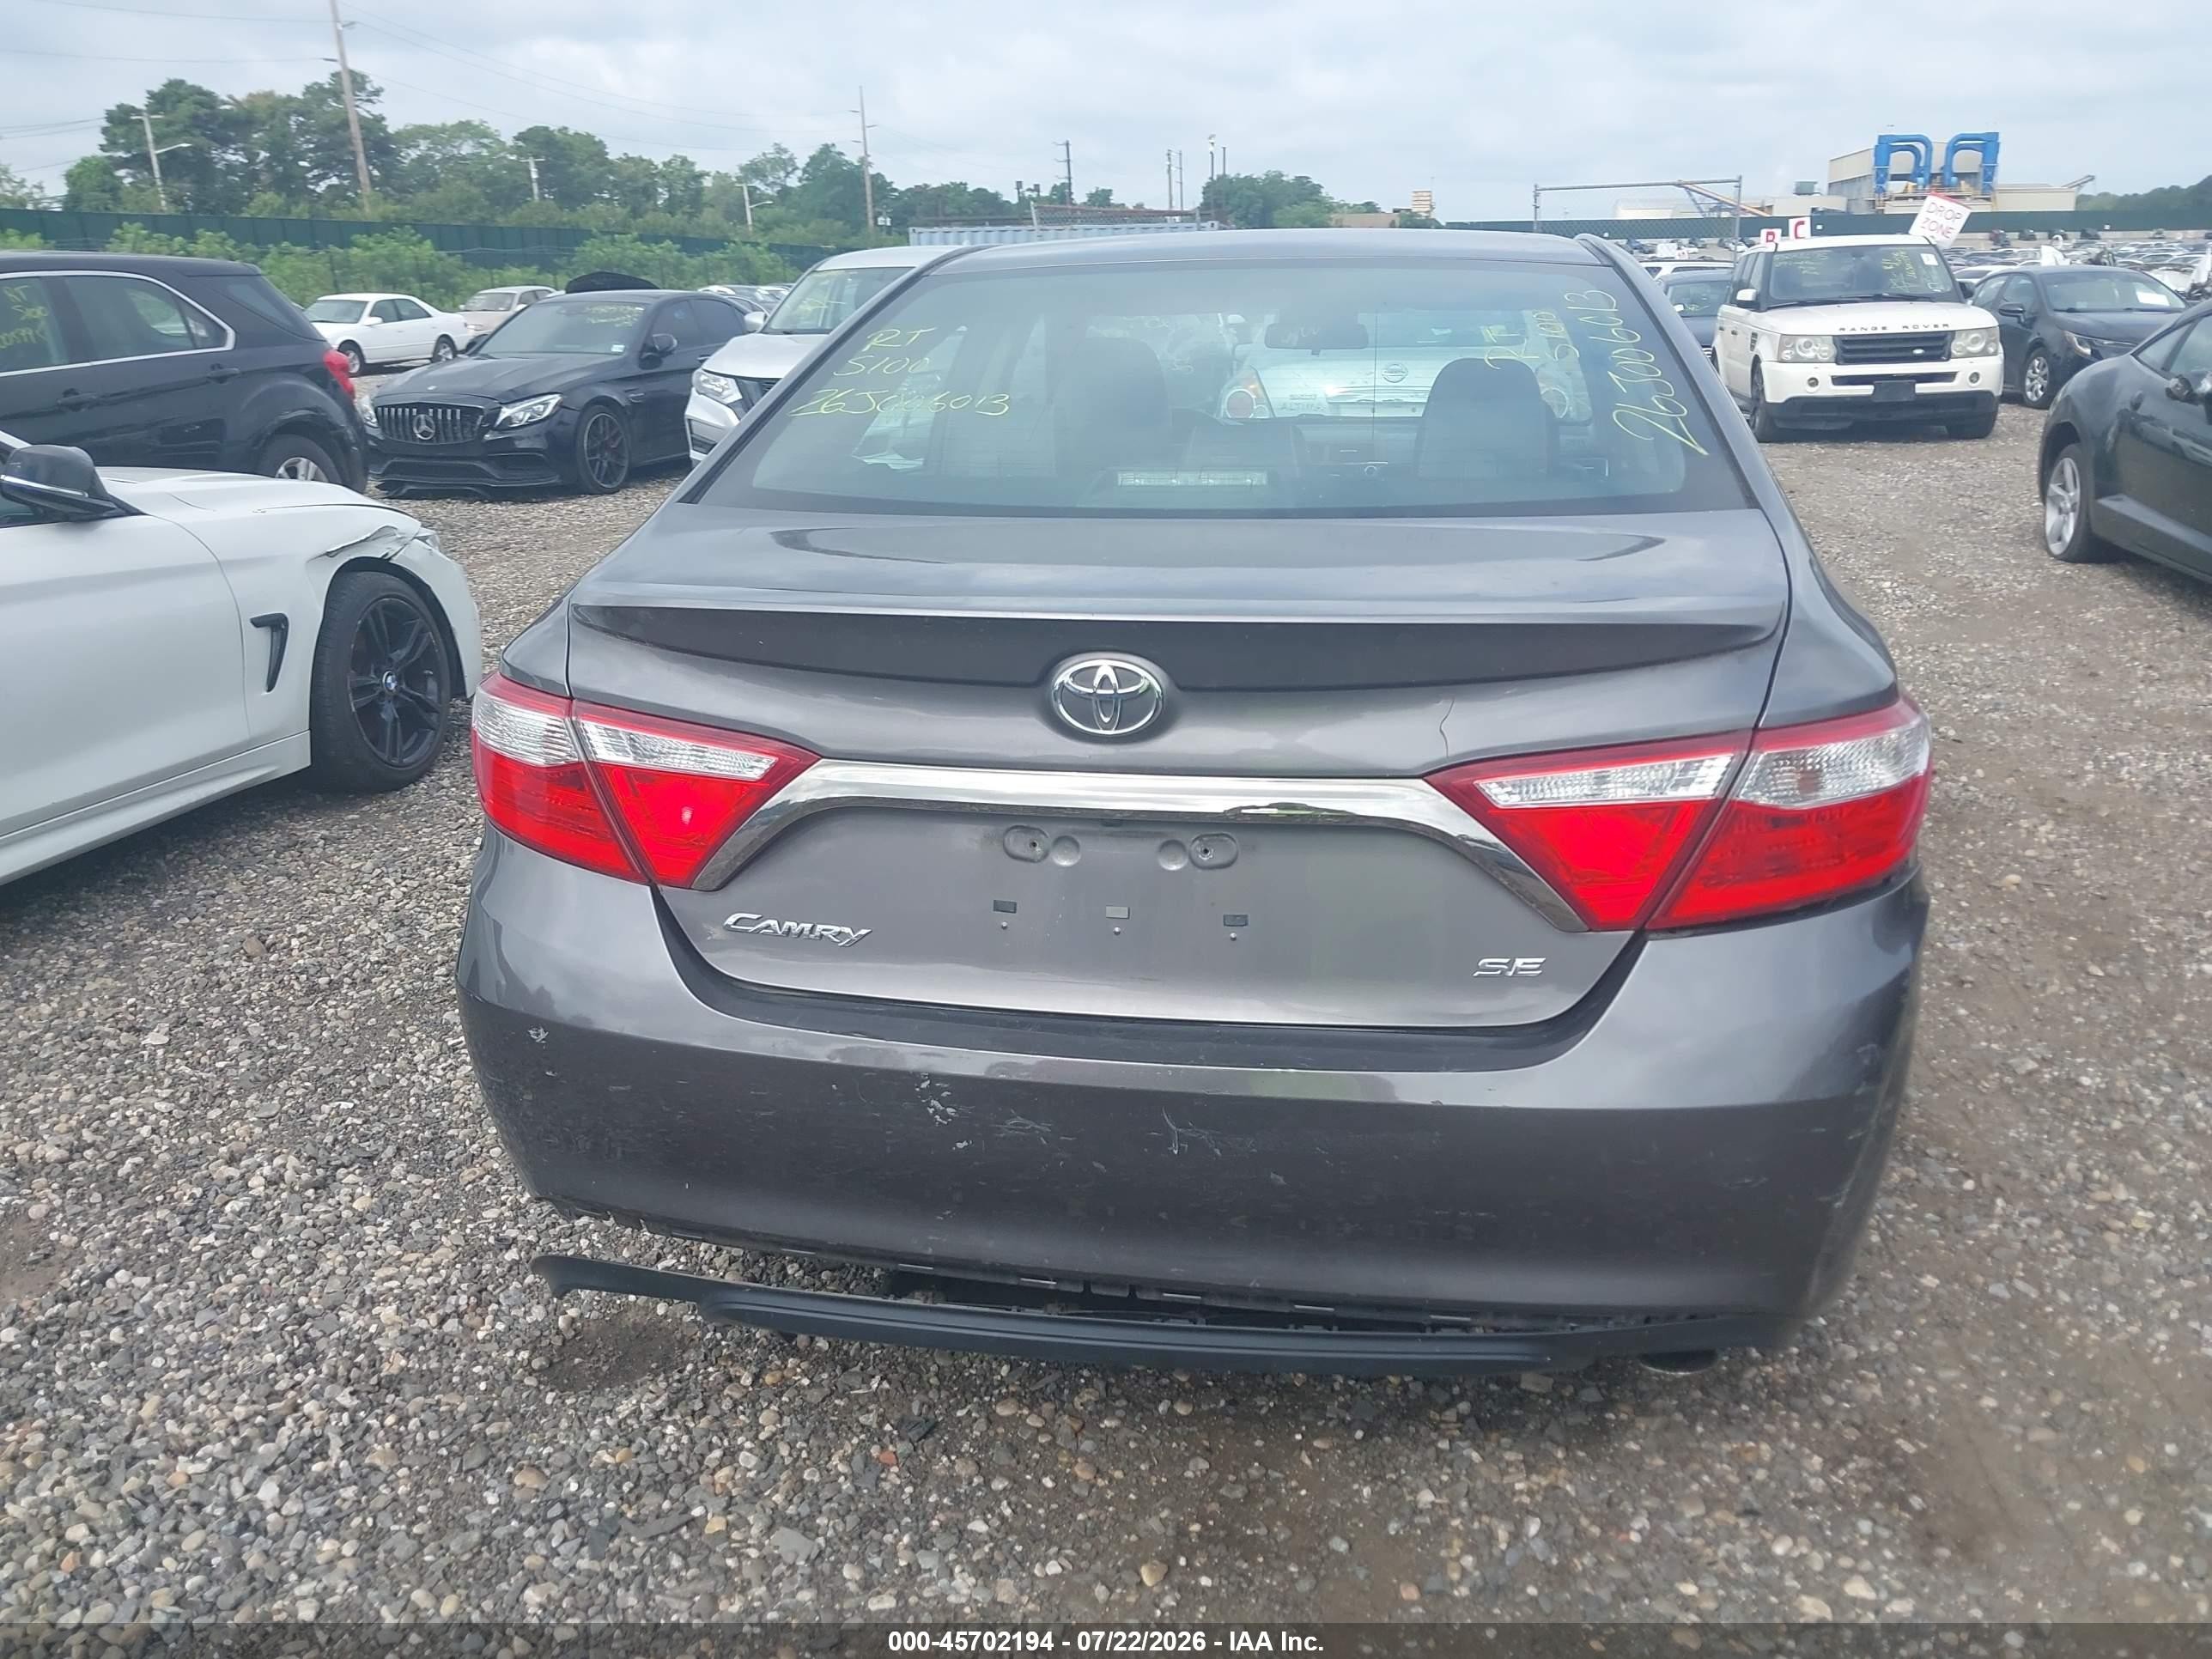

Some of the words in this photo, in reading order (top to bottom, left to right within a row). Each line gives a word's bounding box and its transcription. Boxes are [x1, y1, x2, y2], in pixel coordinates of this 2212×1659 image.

[1925, 202, 1963, 223] DROP
[1919, 217, 1956, 239] ZONE
[861, 327, 938, 352] RT
[723, 912, 872, 947] CAMRY
[1472, 957, 1546, 977] SE
